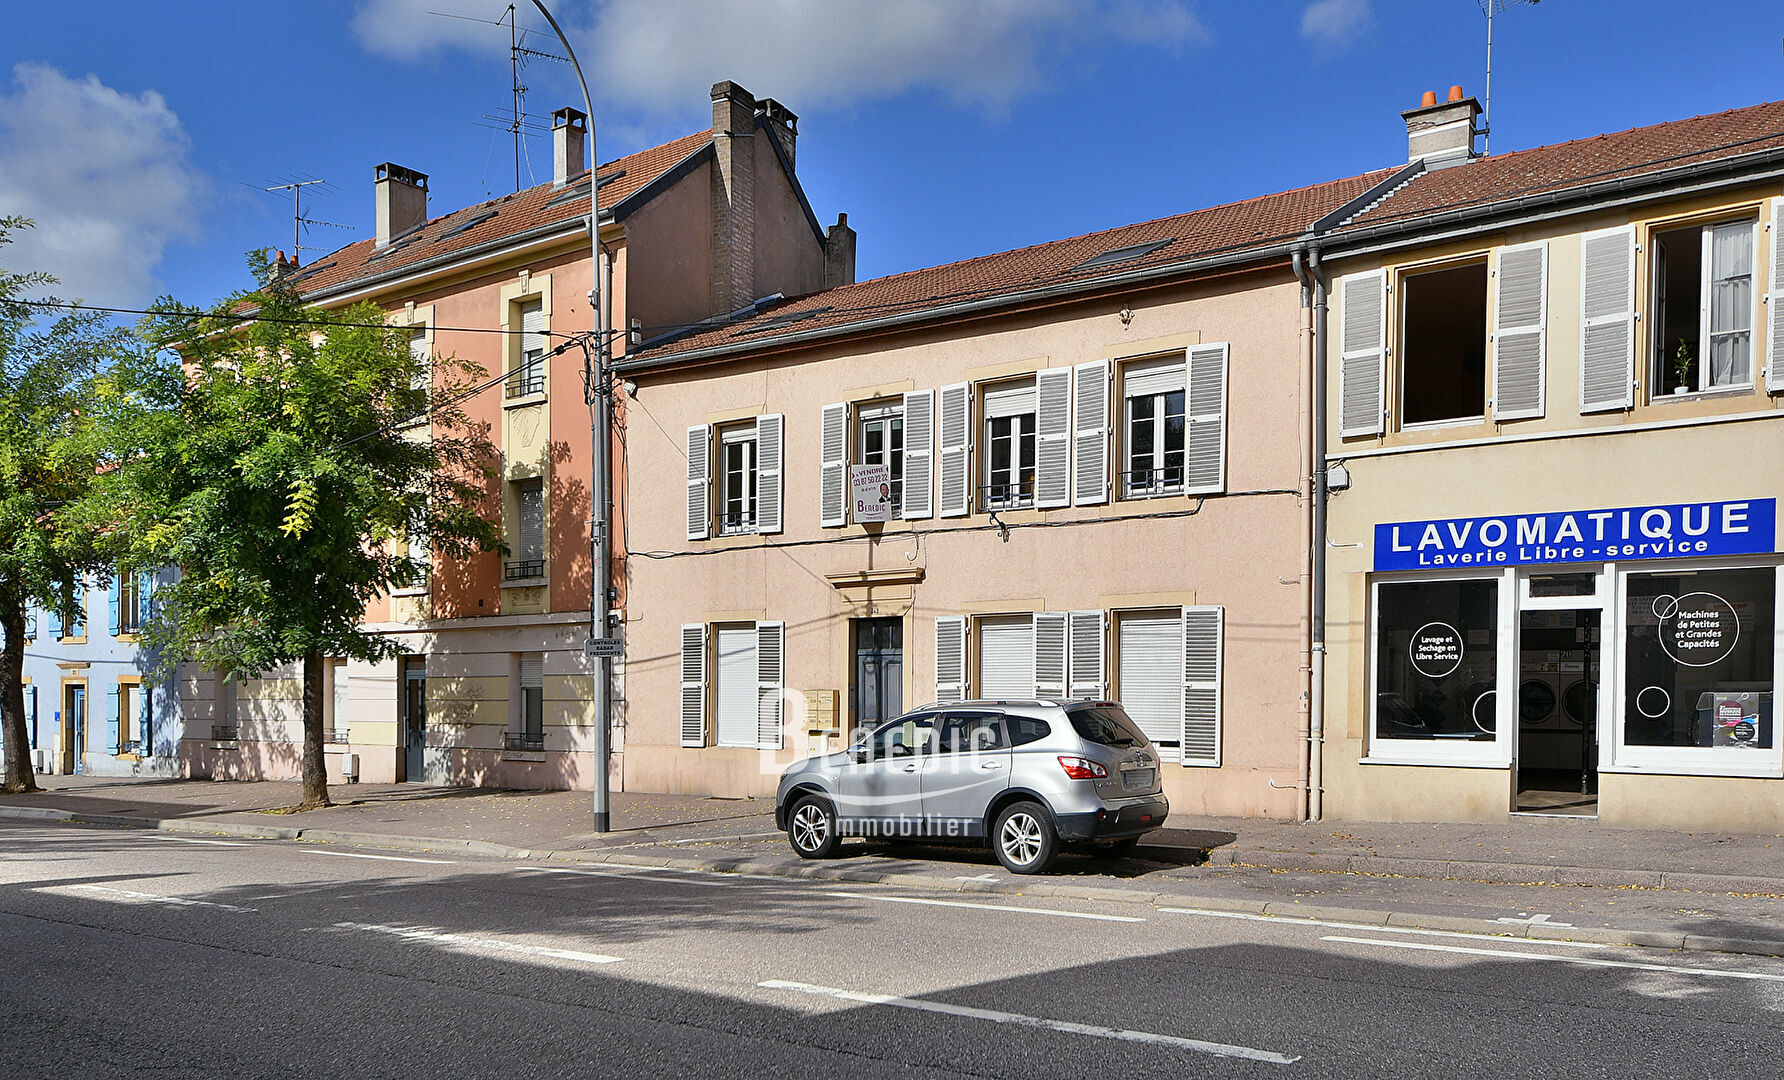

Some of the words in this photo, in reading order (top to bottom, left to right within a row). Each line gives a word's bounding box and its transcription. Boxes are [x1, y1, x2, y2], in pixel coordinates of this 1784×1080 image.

[1392, 502, 1749, 552] LAVOMATIQUE
[1419, 548, 1507, 566] Laverie
[1678, 610, 1720, 619] Machines
[1677, 620, 1688, 629] de
[1689, 620, 1720, 629] Petites
[1675, 631, 1685, 639] et
[1686, 629, 1722, 639] Grandes
[1421, 636, 1445, 645] Lavage
[1677, 639, 1720, 650] Capacités
[1418, 644, 1446, 653] Sechage
[1415, 652, 1433, 660] Libre
[1433, 652, 1459, 660] Service
